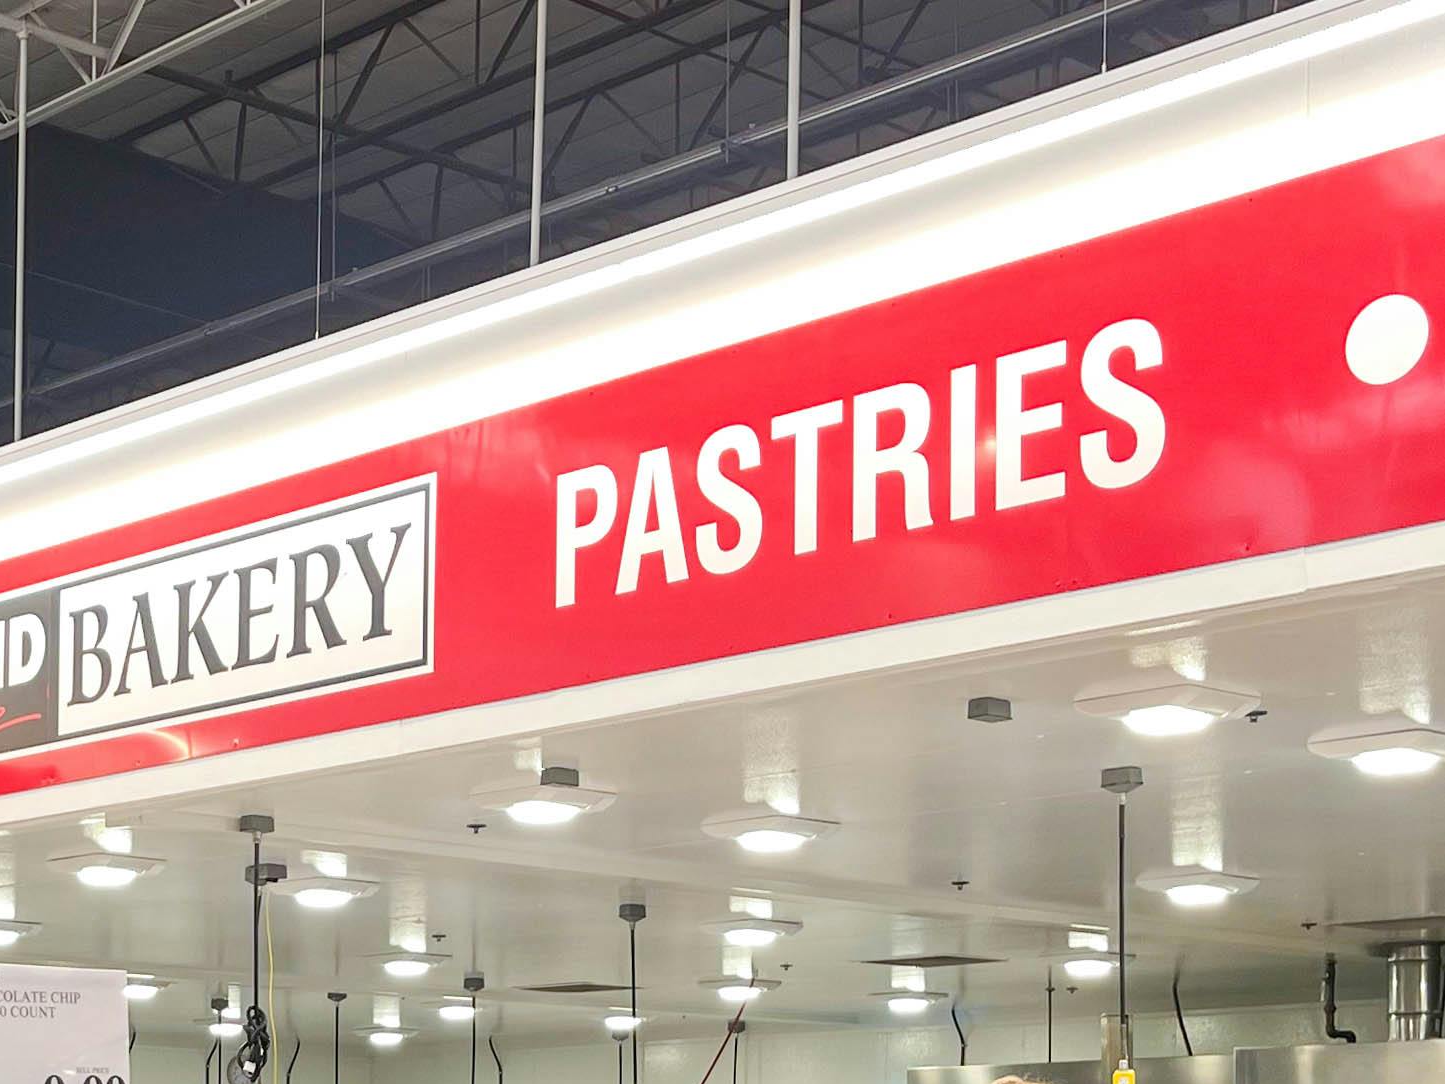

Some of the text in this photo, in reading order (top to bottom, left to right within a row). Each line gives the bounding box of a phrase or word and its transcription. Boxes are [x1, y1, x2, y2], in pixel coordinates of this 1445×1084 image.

[555, 317, 1167, 608] PASTRIES
[66, 523, 413, 707] BAKERY
[10, 1006, 57, 1018] COUNT
[51, 991, 82, 1004] CHIP
